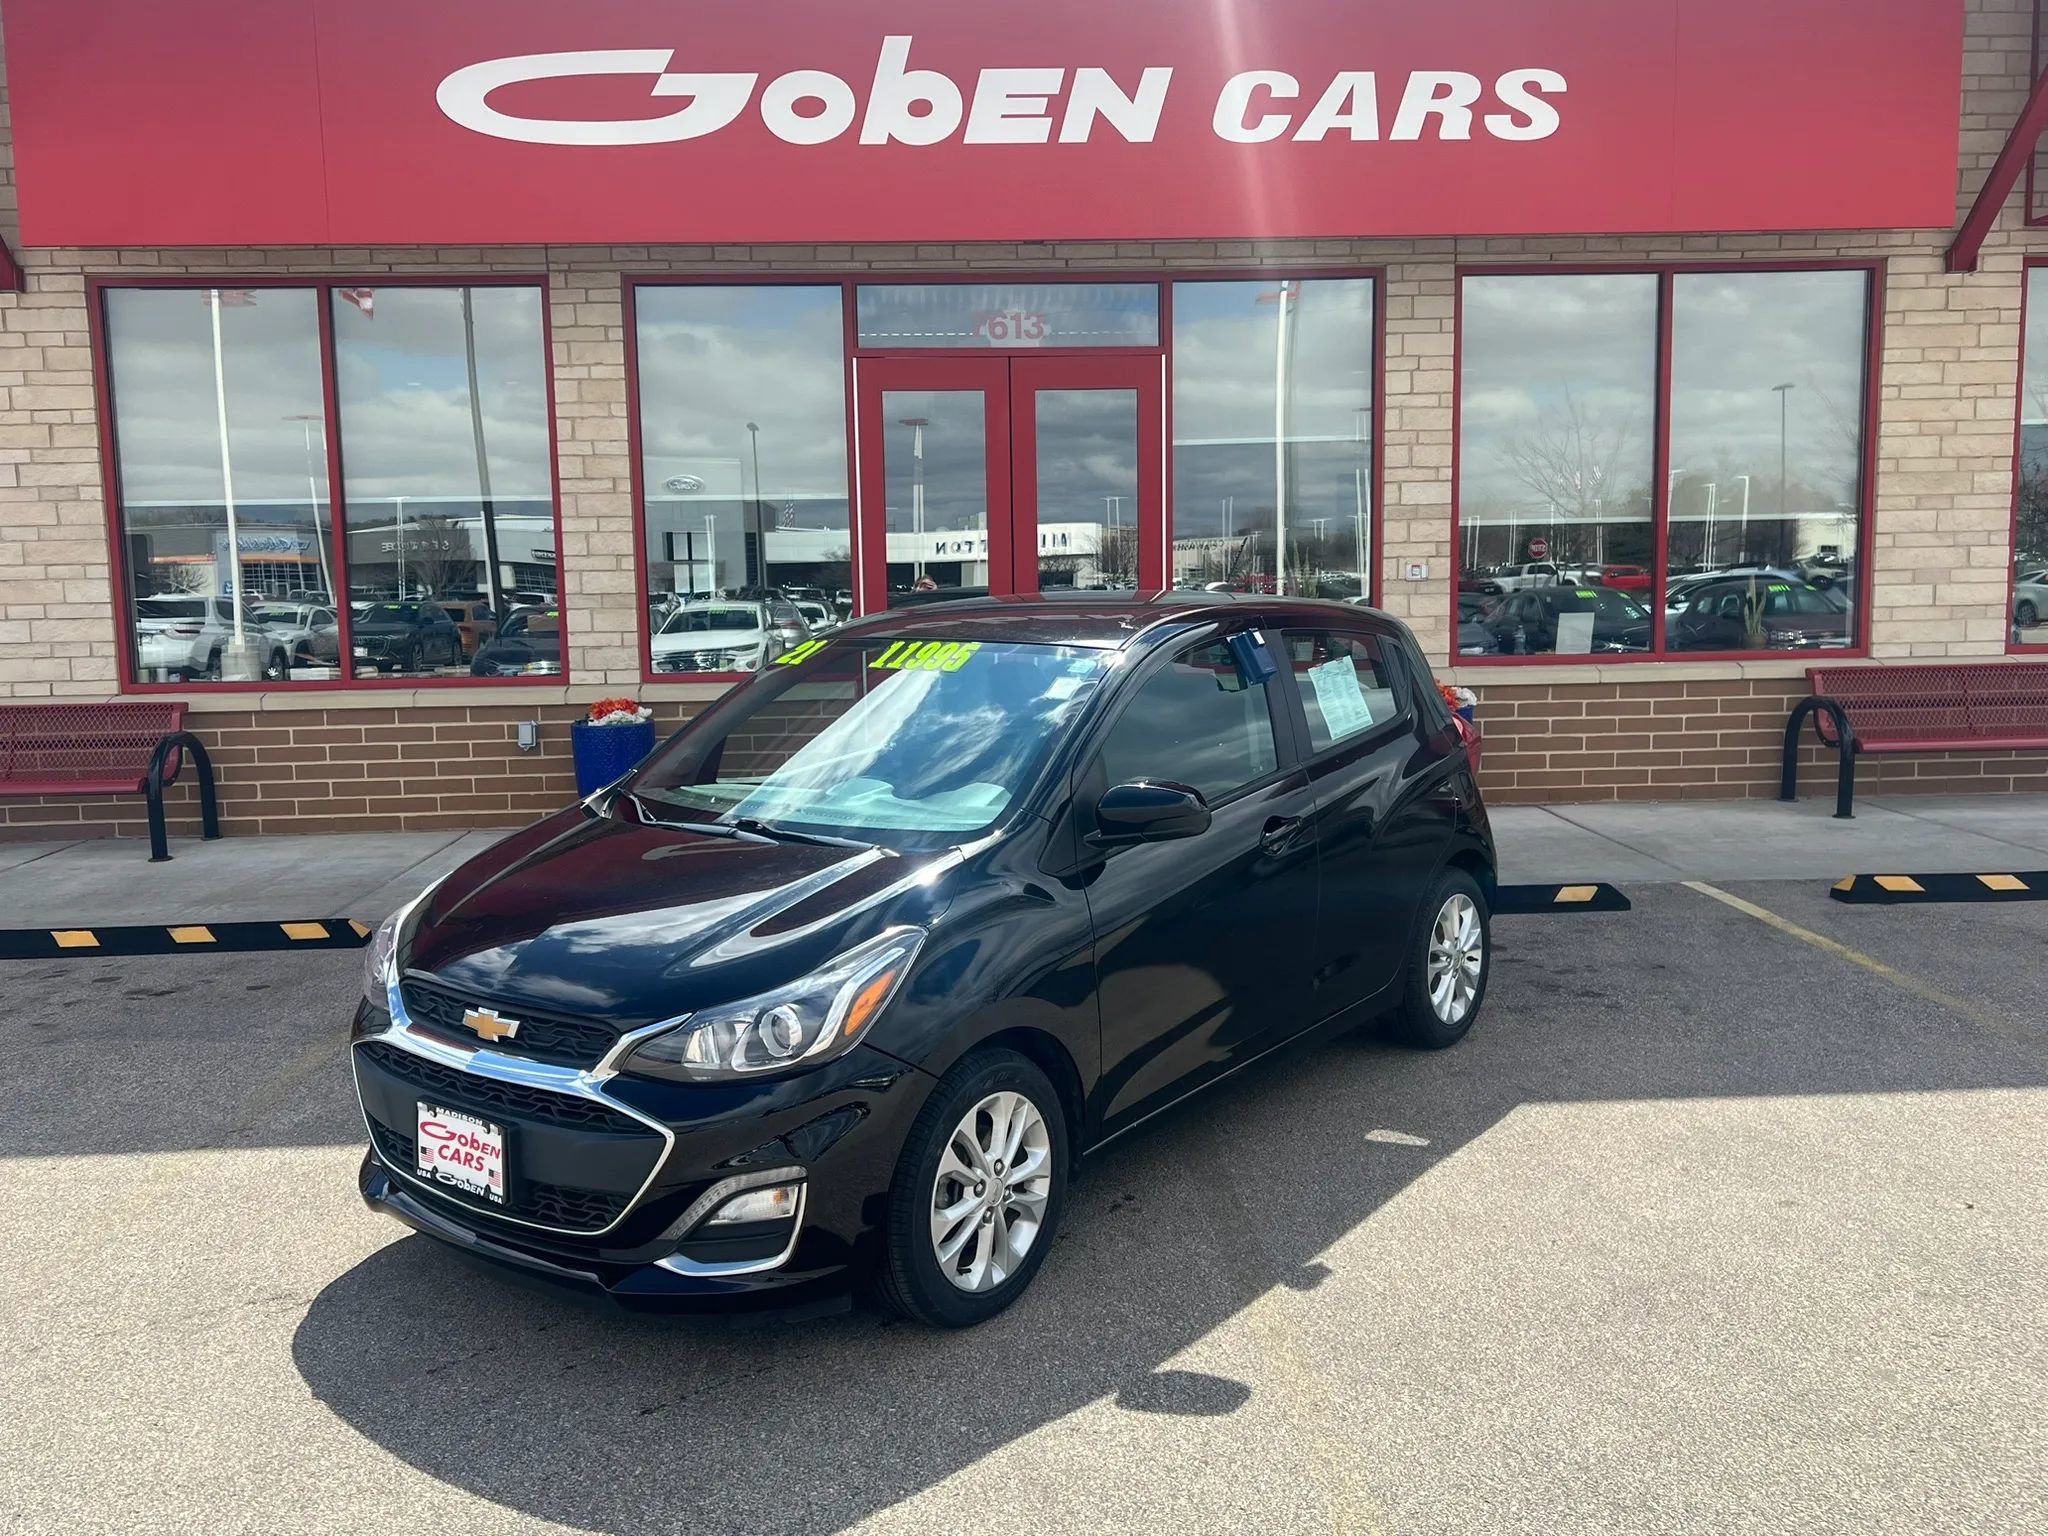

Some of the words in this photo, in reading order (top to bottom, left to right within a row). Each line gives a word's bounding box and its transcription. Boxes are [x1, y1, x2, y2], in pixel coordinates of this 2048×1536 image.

[1211, 68, 1568, 143] CARS
[774, 639, 829, 666] 21
[868, 641, 982, 672] 11995
[435, 1107, 484, 1126] MADISON
[438, 1144, 486, 1172] CARS
[416, 1168, 432, 1179] USA
[489, 1193, 503, 1205] USA
